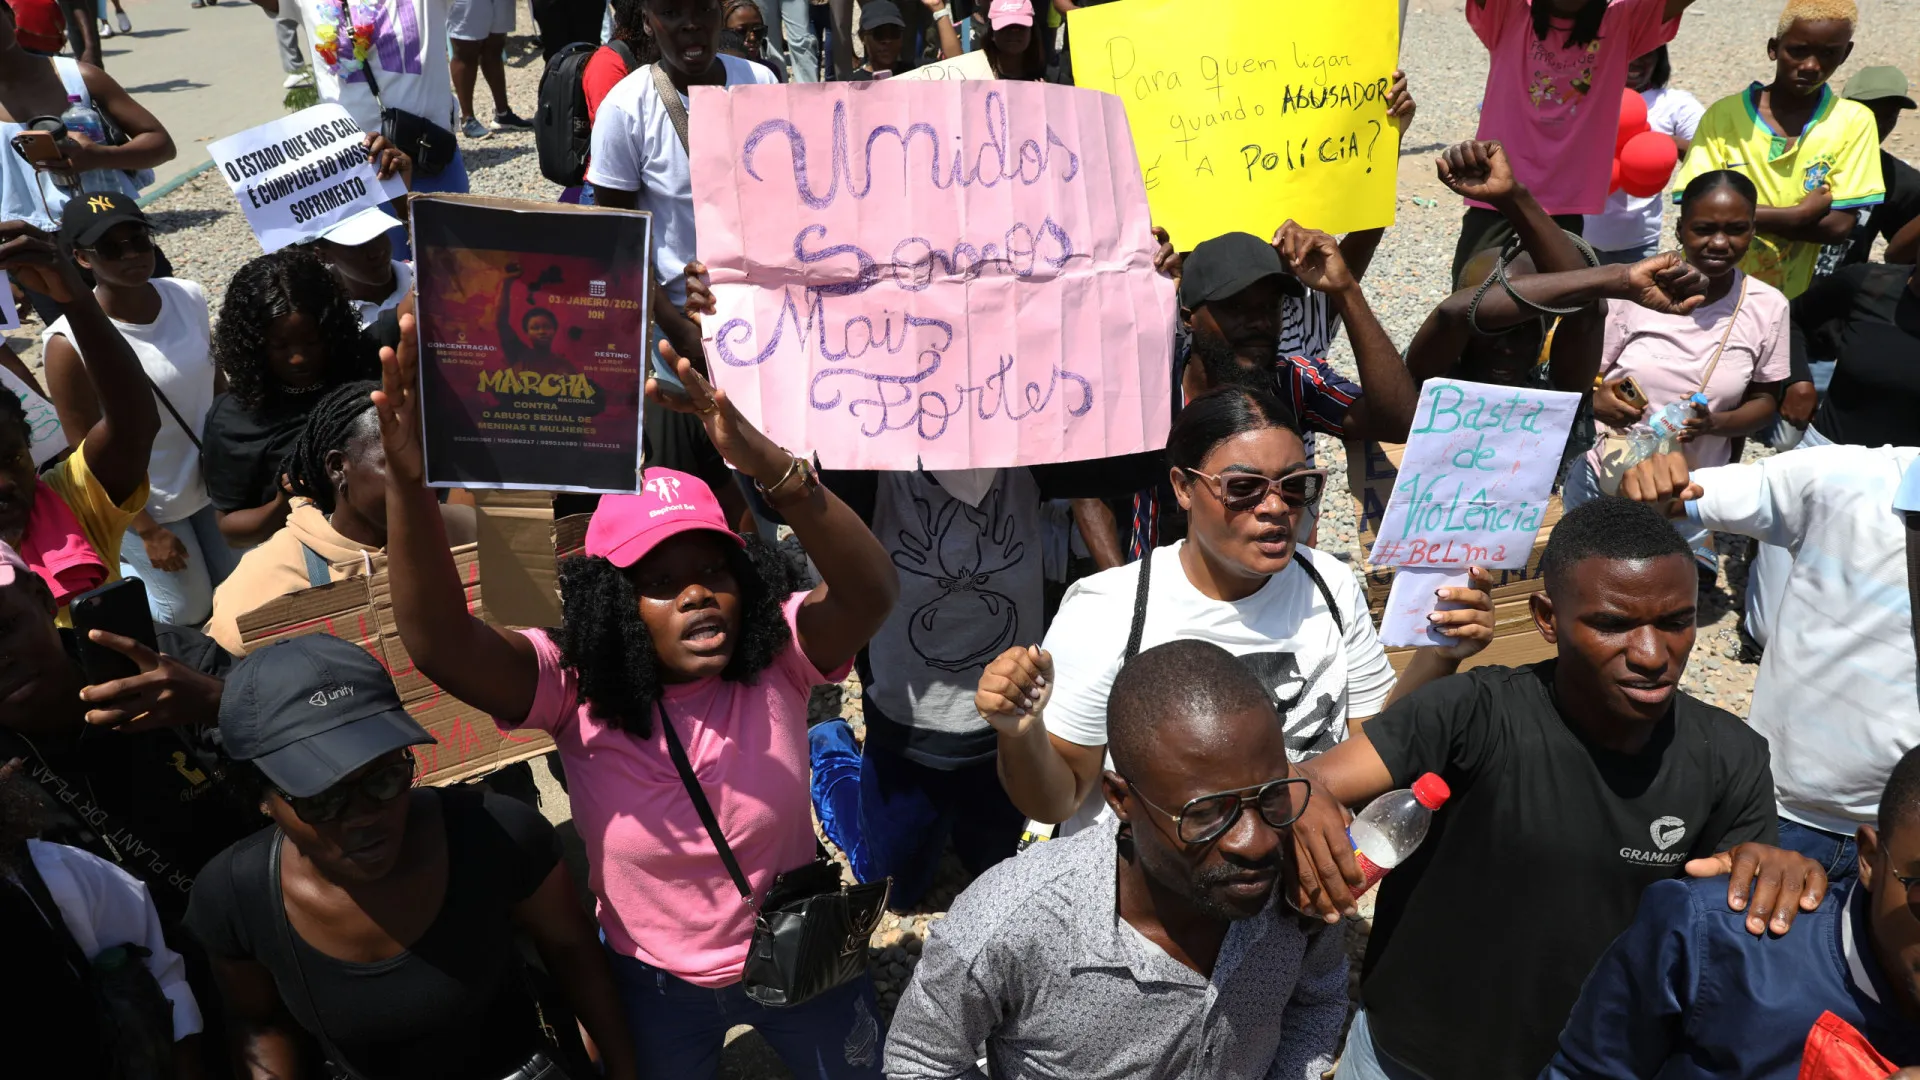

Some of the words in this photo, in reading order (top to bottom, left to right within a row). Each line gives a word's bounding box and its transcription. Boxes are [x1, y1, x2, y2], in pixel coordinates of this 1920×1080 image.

[1105, 35, 1182, 100] Para
[1291, 41, 1352, 86] ligar
[1169, 96, 1265, 160] quando
[224, 161, 241, 183] O
[235, 143, 286, 178] ESTADO
[282, 135, 312, 161] QUE
[304, 124, 336, 153] NOS
[743, 90, 1079, 210] Unidos
[246, 182, 260, 209] É
[318, 156, 338, 178] DO
[335, 141, 370, 173] NOSS
[1144, 154, 1162, 191] É
[1195, 156, 1214, 177] A
[289, 176, 367, 224] SOFRIMENTO
[793, 214, 1074, 297] Somos
[588, 310, 605, 319] 10H
[716, 283, 953, 368] Mais
[594, 351, 631, 359] DESTINO:
[477, 368, 596, 399] MARCHA
[557, 397, 595, 405] NACIONAL
[809, 343, 1093, 441] Fortes
[494, 412, 530, 421] ABUSO
[533, 413, 575, 423] SEXUAL
[577, 415, 592, 424] DE
[513, 401, 558, 410] CONTRA
[1412, 384, 1545, 434] Basta
[478, 422, 527, 431] MENINAS
[530, 424, 537, 432] E
[539, 425, 597, 435] MULHERES
[1452, 434, 1496, 471] de
[328, 685, 354, 700] unity
